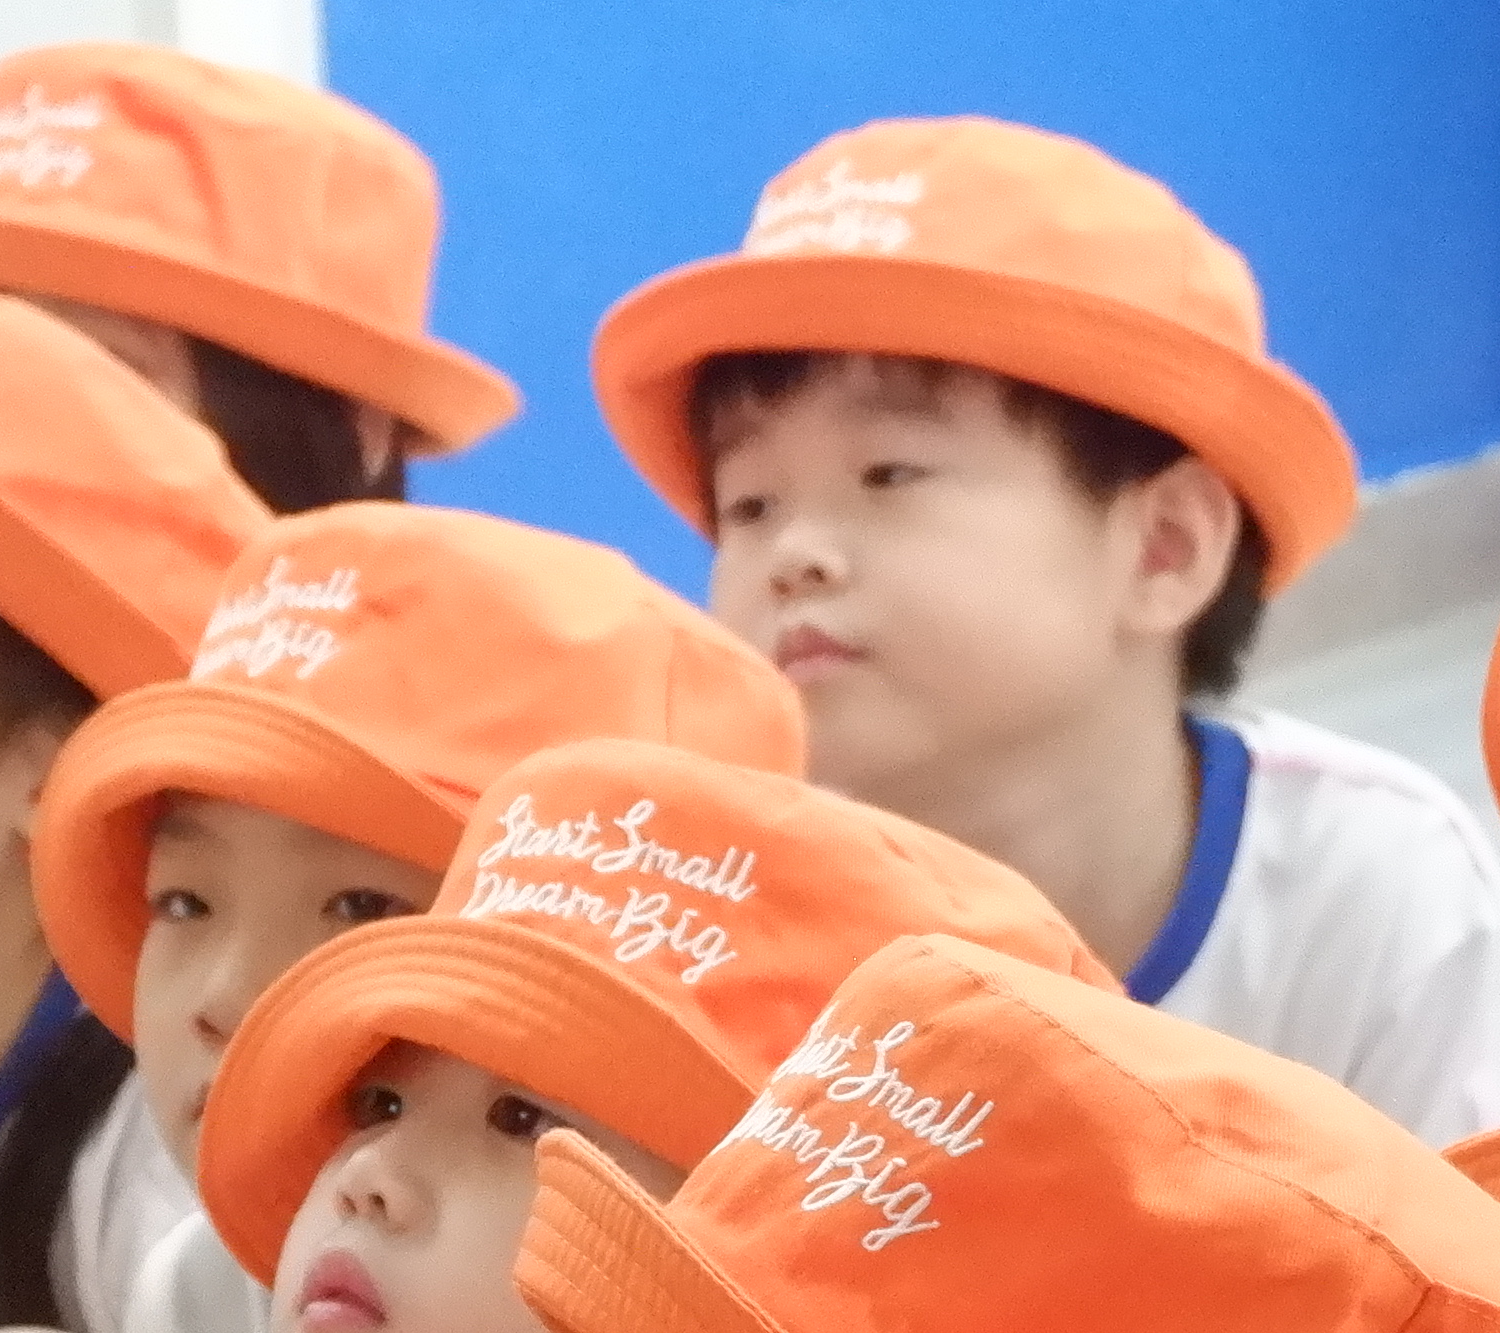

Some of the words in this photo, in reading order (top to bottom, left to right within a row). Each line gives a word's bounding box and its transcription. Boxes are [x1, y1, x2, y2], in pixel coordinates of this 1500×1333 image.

[246, 619, 340, 681] Big
[477, 794, 602, 868] Start
[592, 799, 758, 902] Small
[458, 870, 614, 926] Dream
[610, 886, 738, 985] Big
[826, 1020, 995, 1158] Small
[801, 1121, 941, 1251] Big
